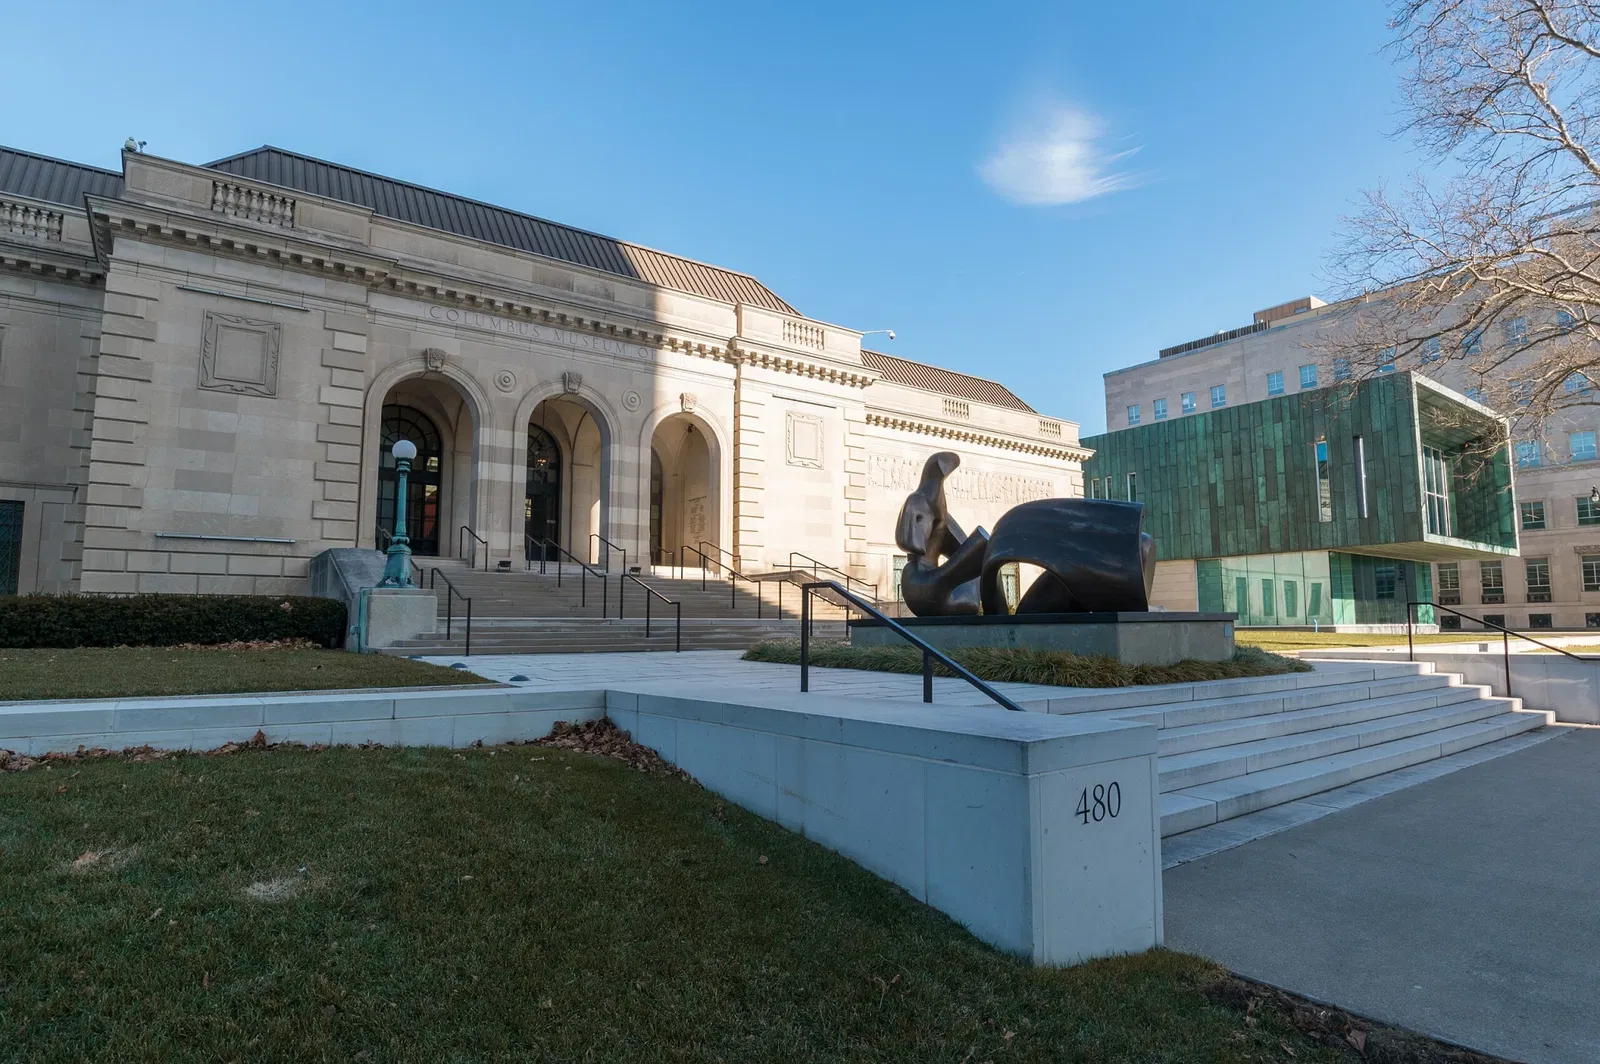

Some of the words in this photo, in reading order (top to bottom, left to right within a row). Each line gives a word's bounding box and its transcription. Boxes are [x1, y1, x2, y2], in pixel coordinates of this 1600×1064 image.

[429, 305, 541, 338] COLUMBUS
[553, 329, 627, 355] MUSEUM
[637, 346, 657, 361] OF
[1074, 781, 1121, 826] 480
